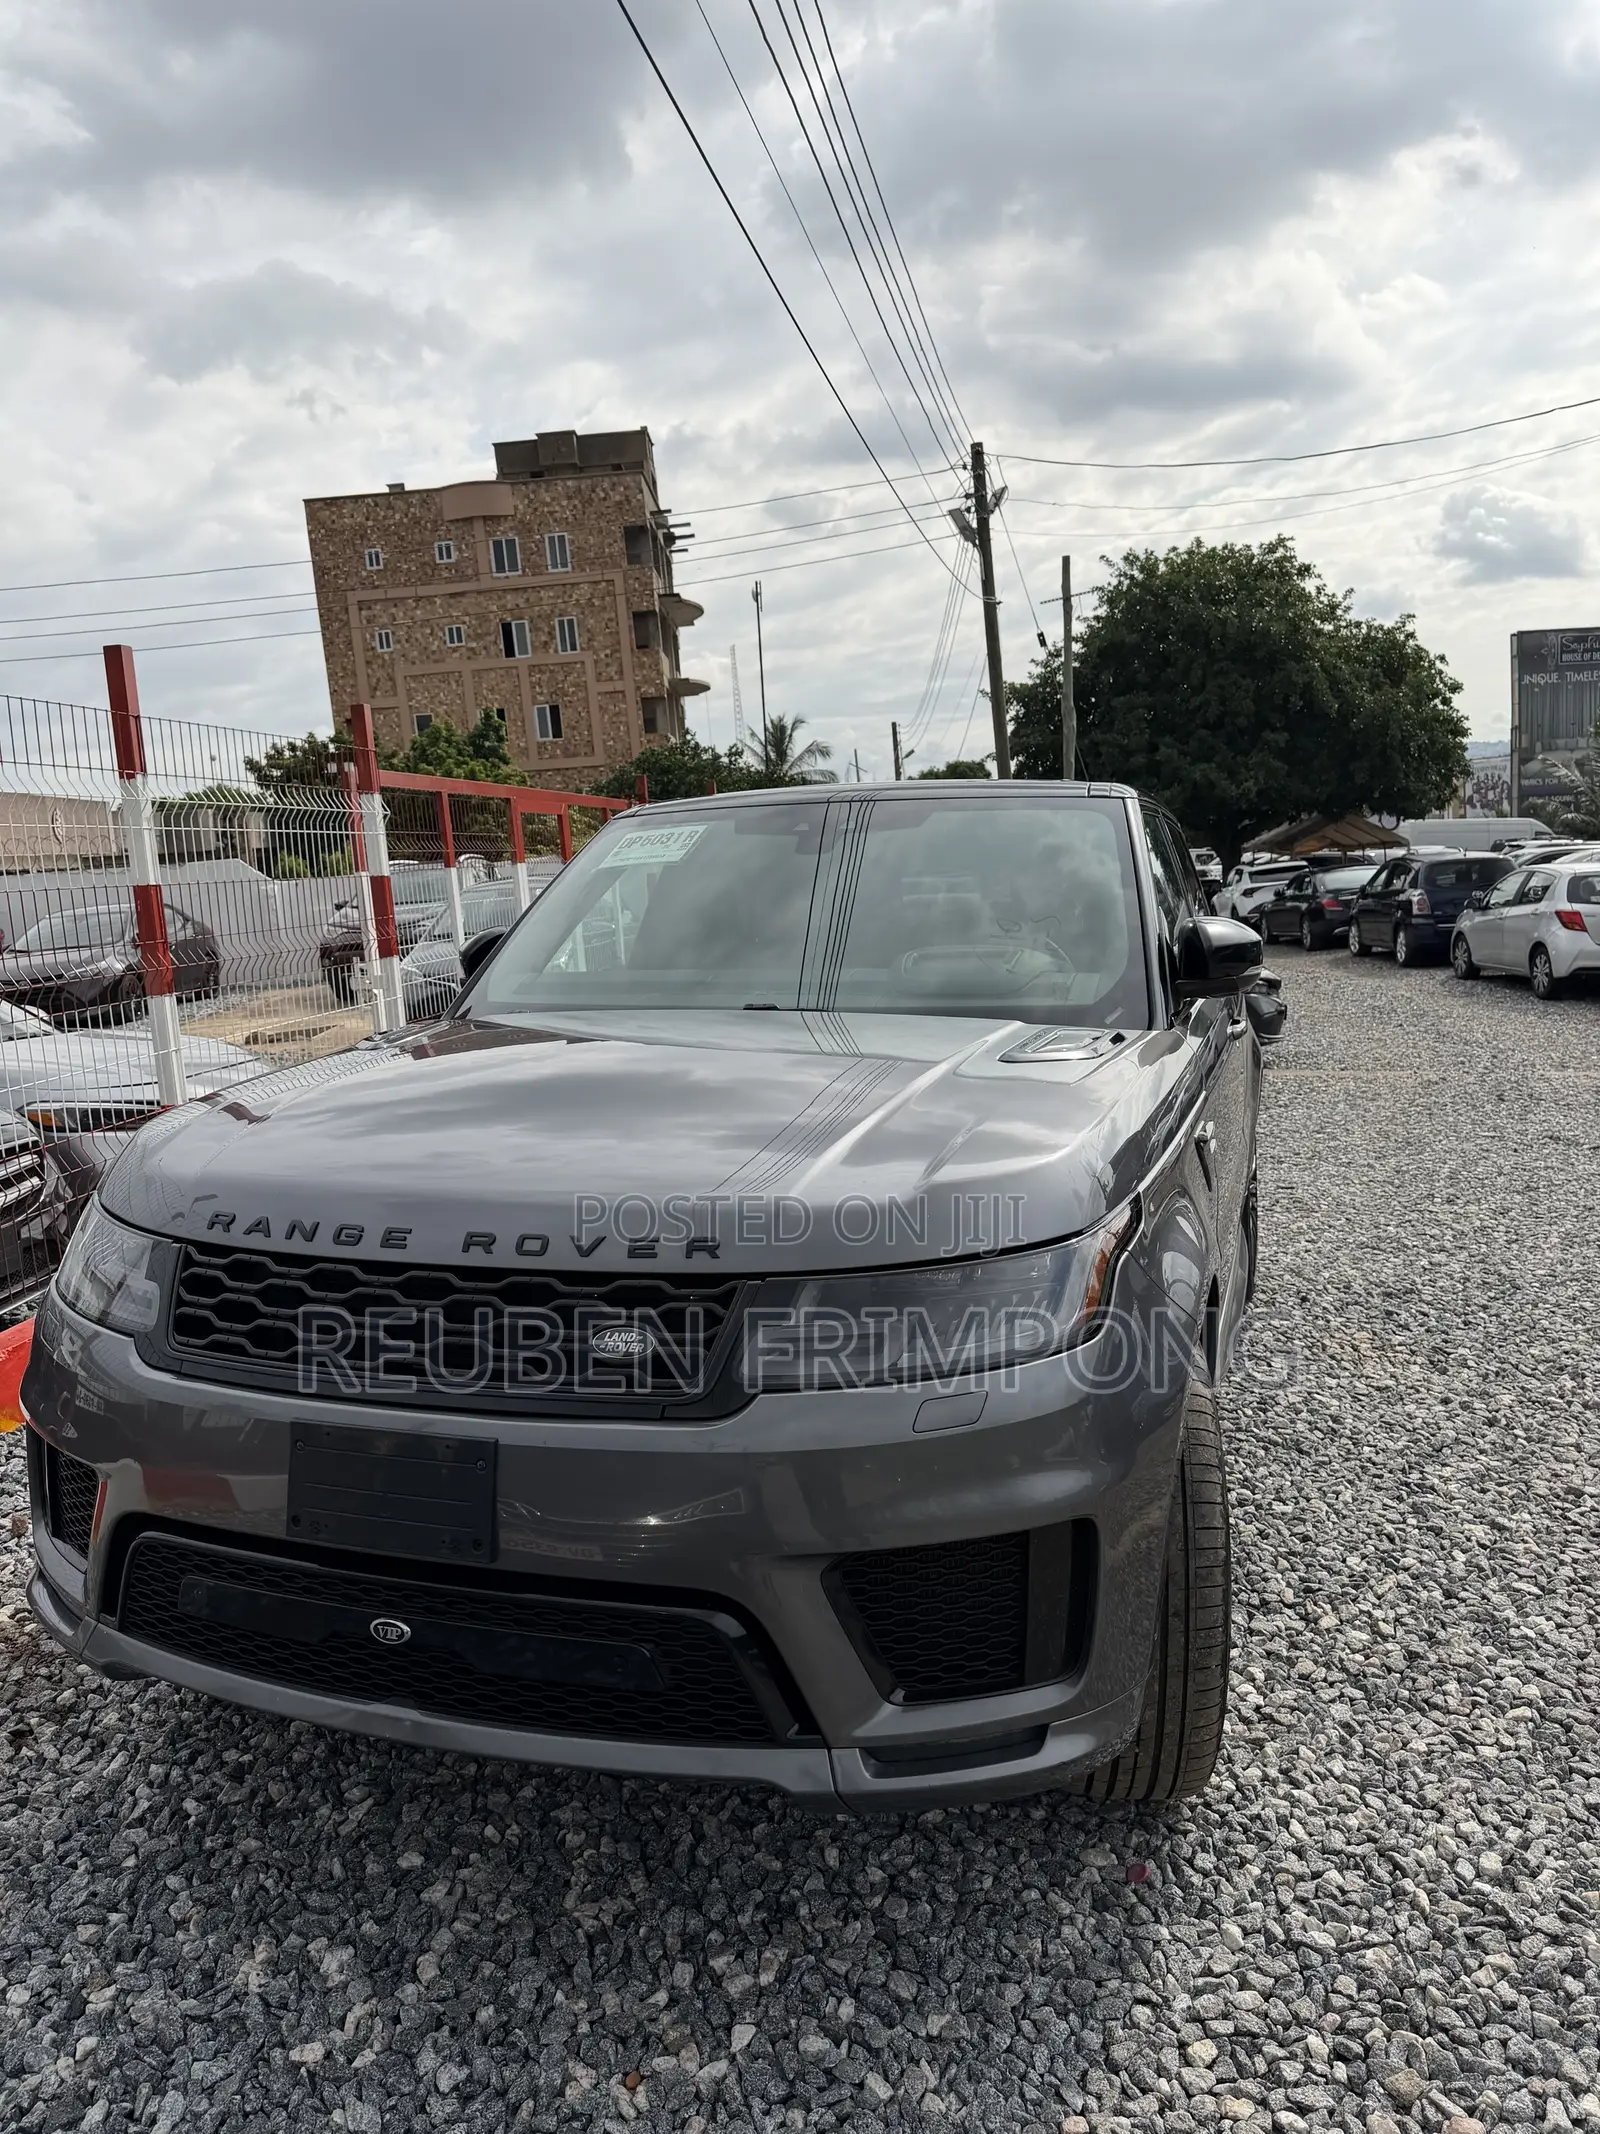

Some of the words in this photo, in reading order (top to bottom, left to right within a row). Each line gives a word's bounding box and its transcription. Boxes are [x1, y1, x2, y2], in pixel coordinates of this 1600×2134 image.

[1562, 652, 1582, 662] HOUSE
[1583, 652, 1592, 662] OF
[1565, 670, 1600, 682] TIMELE
[205, 1210, 413, 1250] RANGE
[461, 1230, 721, 1260] ROVER
[604, 1332, 636, 1342] LAND
[605, 1342, 645, 1353] ROVER
[377, 1625, 402, 1640] VIP
